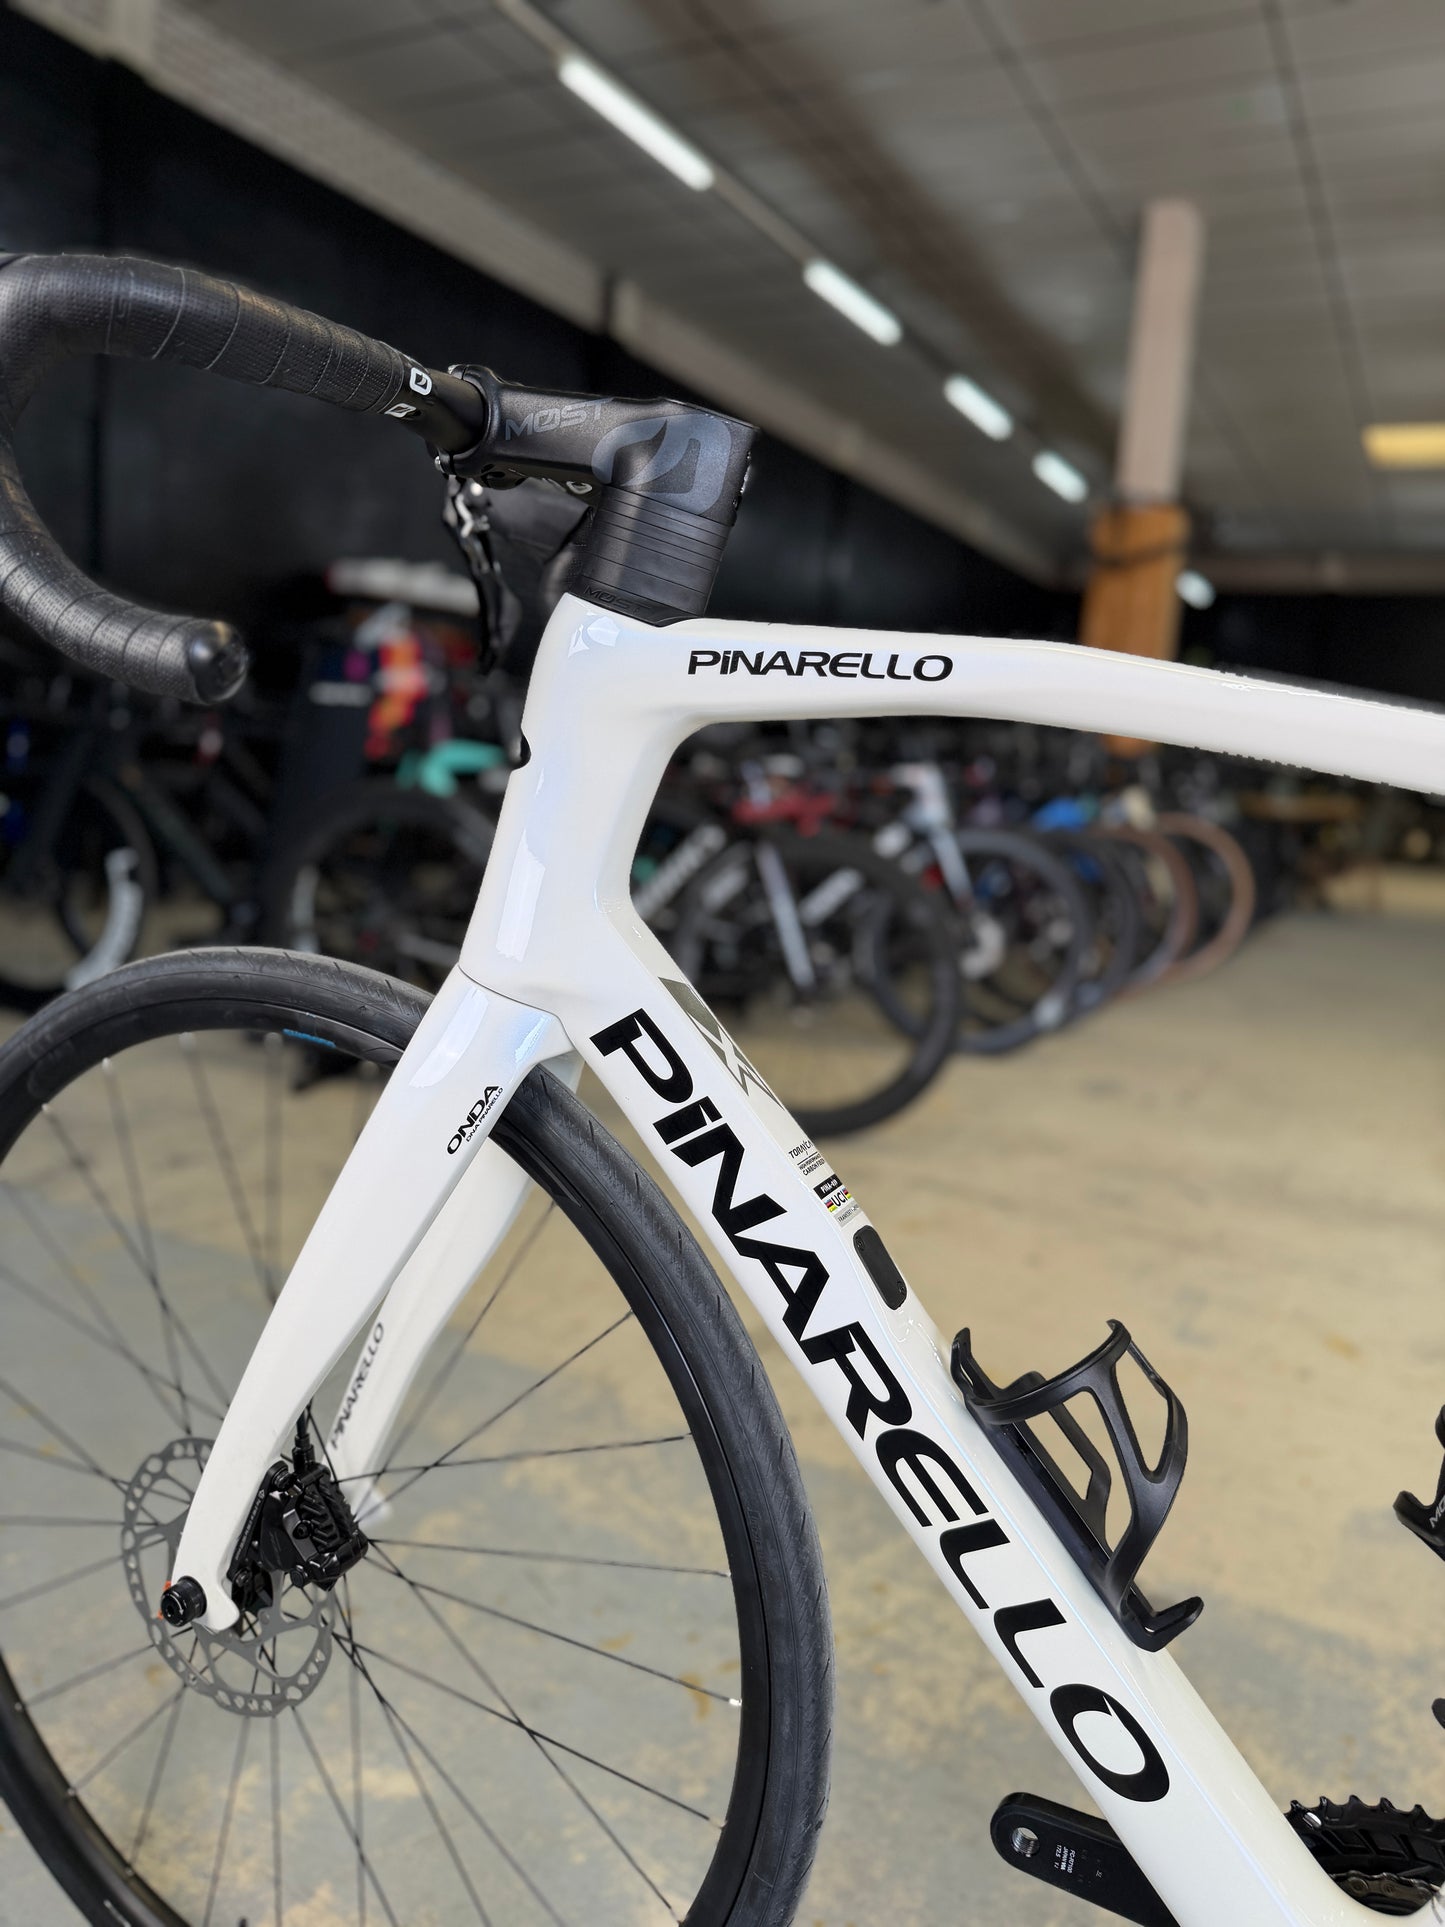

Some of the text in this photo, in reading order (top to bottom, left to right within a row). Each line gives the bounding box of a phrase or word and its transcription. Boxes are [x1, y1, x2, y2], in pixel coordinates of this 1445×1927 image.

[505, 397, 613, 440] MOST
[447, 1086, 499, 1155] ONDA
[466, 1124, 480, 1142] DNA
[831, 1190, 849, 1207] UCI
